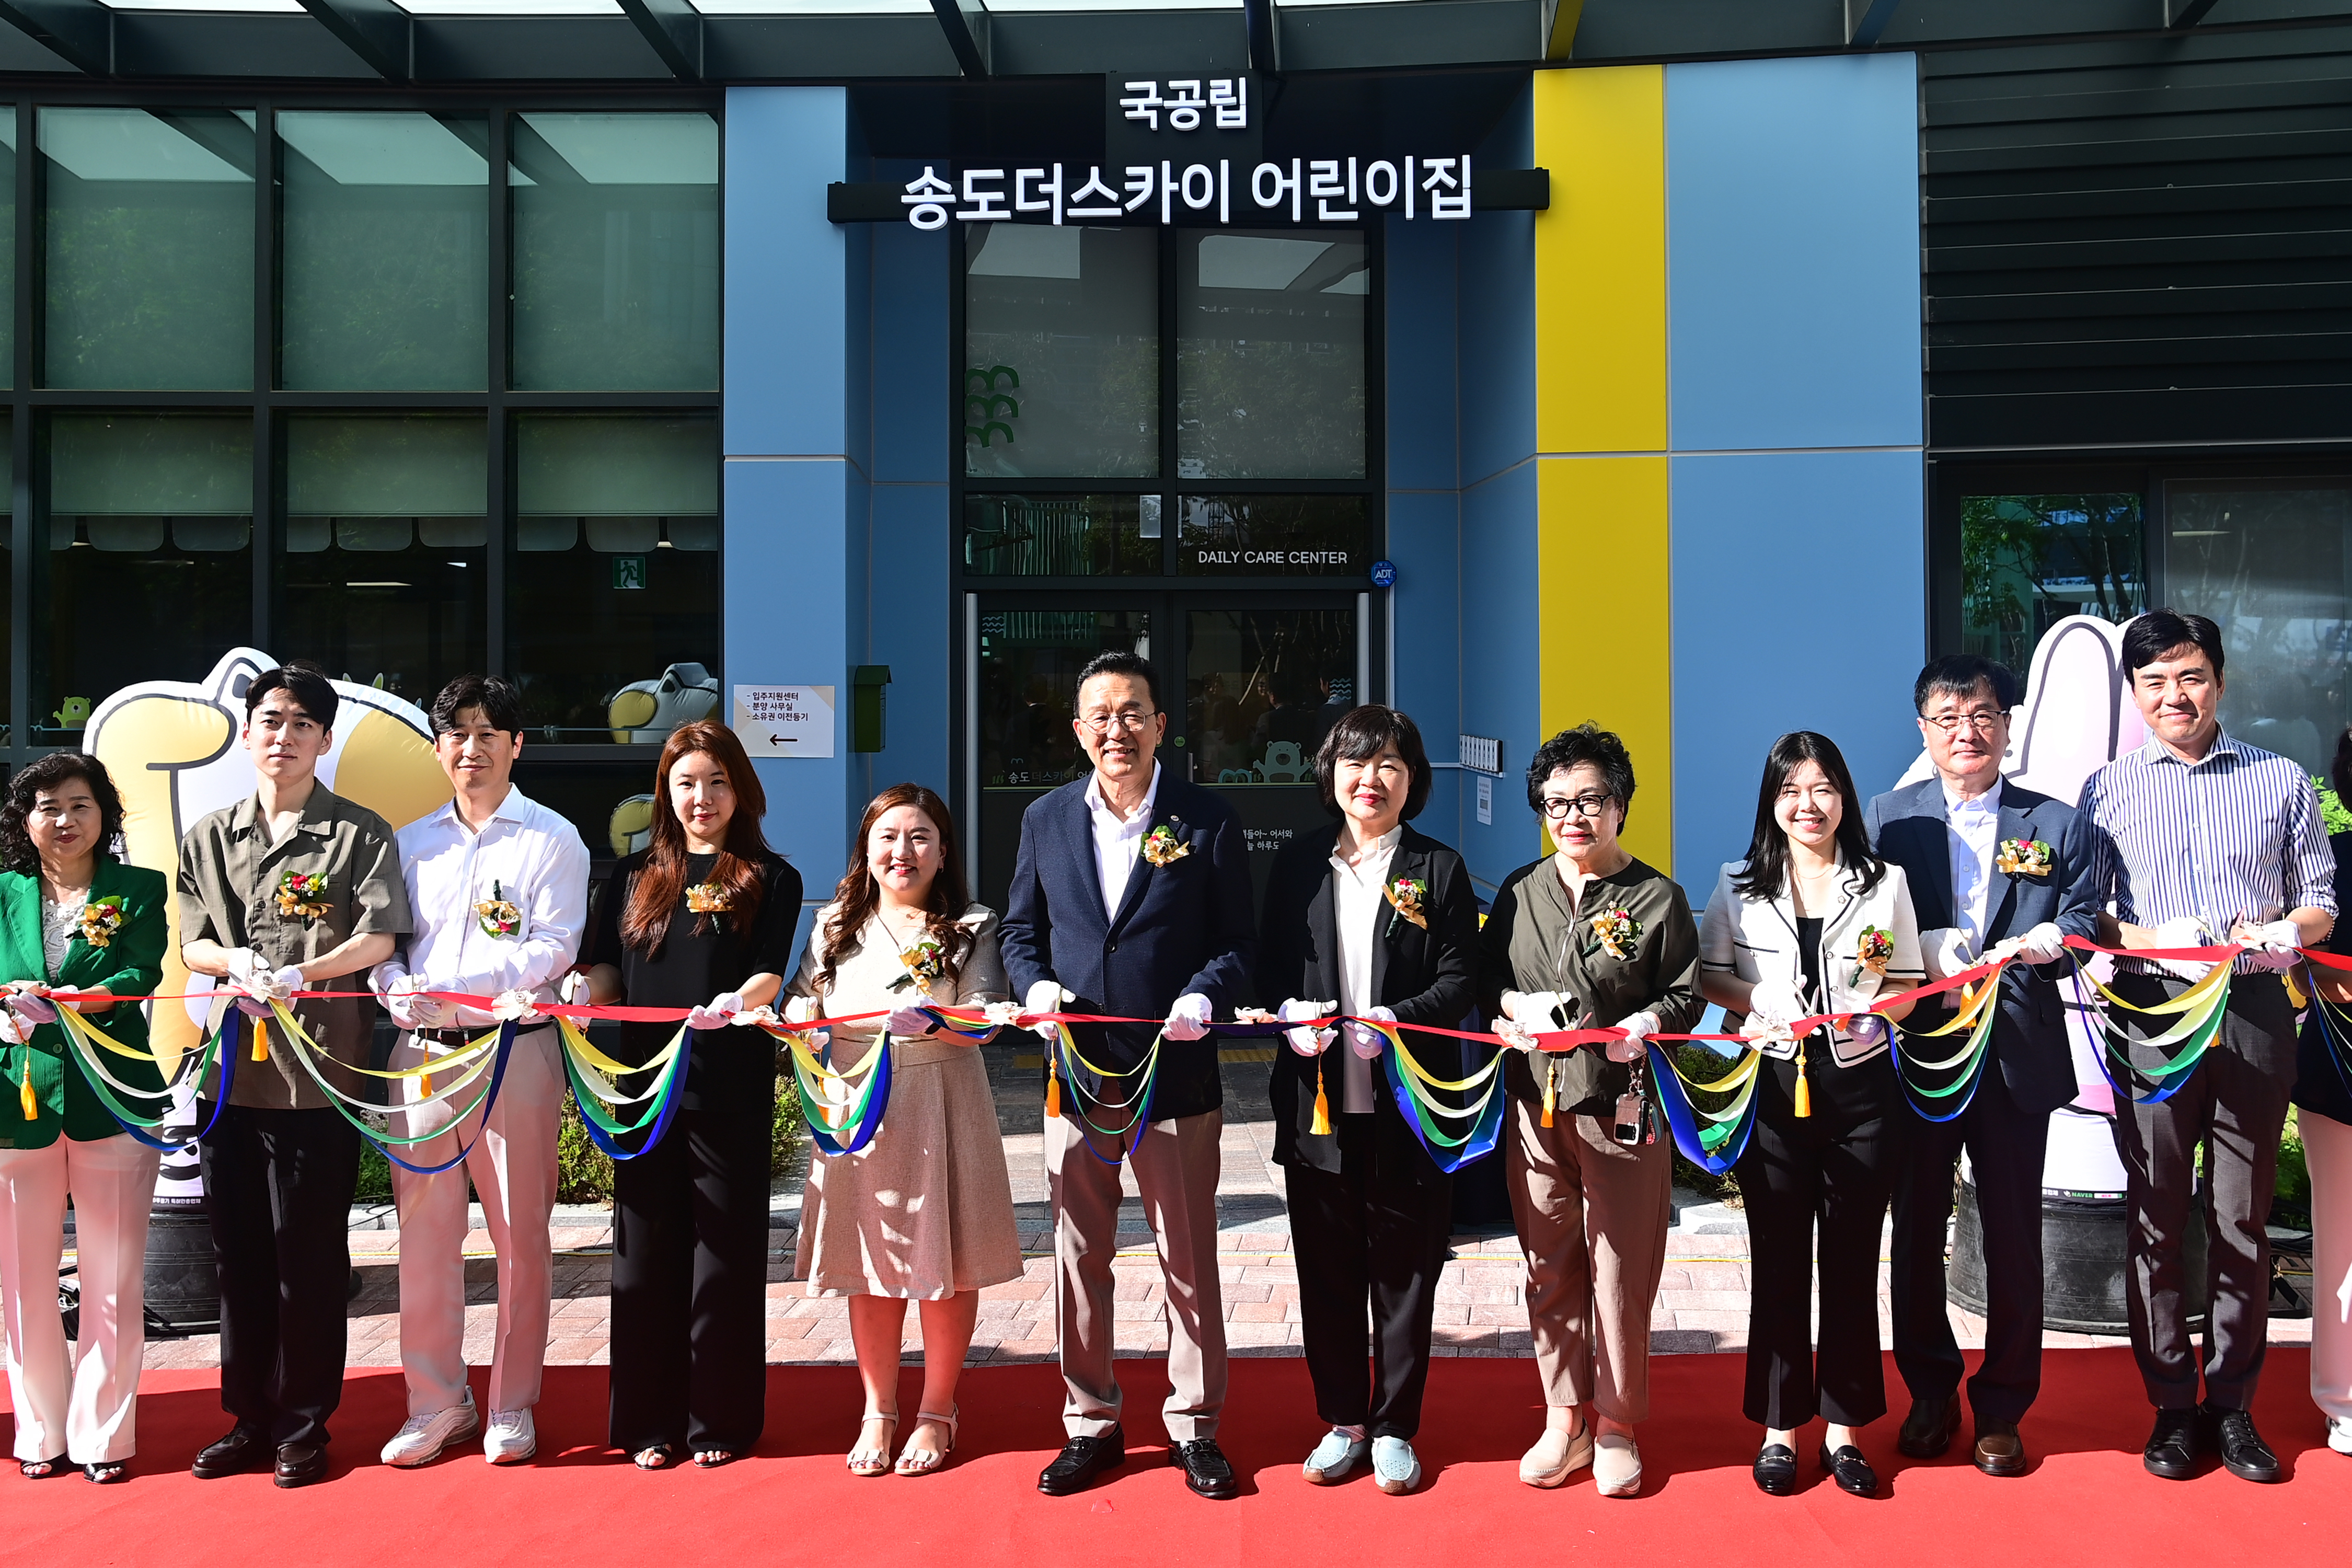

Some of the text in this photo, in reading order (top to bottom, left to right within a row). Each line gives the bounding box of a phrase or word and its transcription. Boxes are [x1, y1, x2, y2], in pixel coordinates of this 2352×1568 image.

[1120, 77, 1247, 131] 국공립
[901, 155, 1471, 230] 송도더스카이 어린이집
[1198, 551, 1347, 564] DAILY CARE CENTER
[1375, 569, 1392, 579] ADT
[753, 691, 799, 701] 입주지원센터
[752, 702, 792, 711] 분양 사무실
[752, 712, 808, 721] 소유권 이전등기
[1270, 829, 1293, 839] 어서와
[1257, 840, 1279, 850] 하루도
